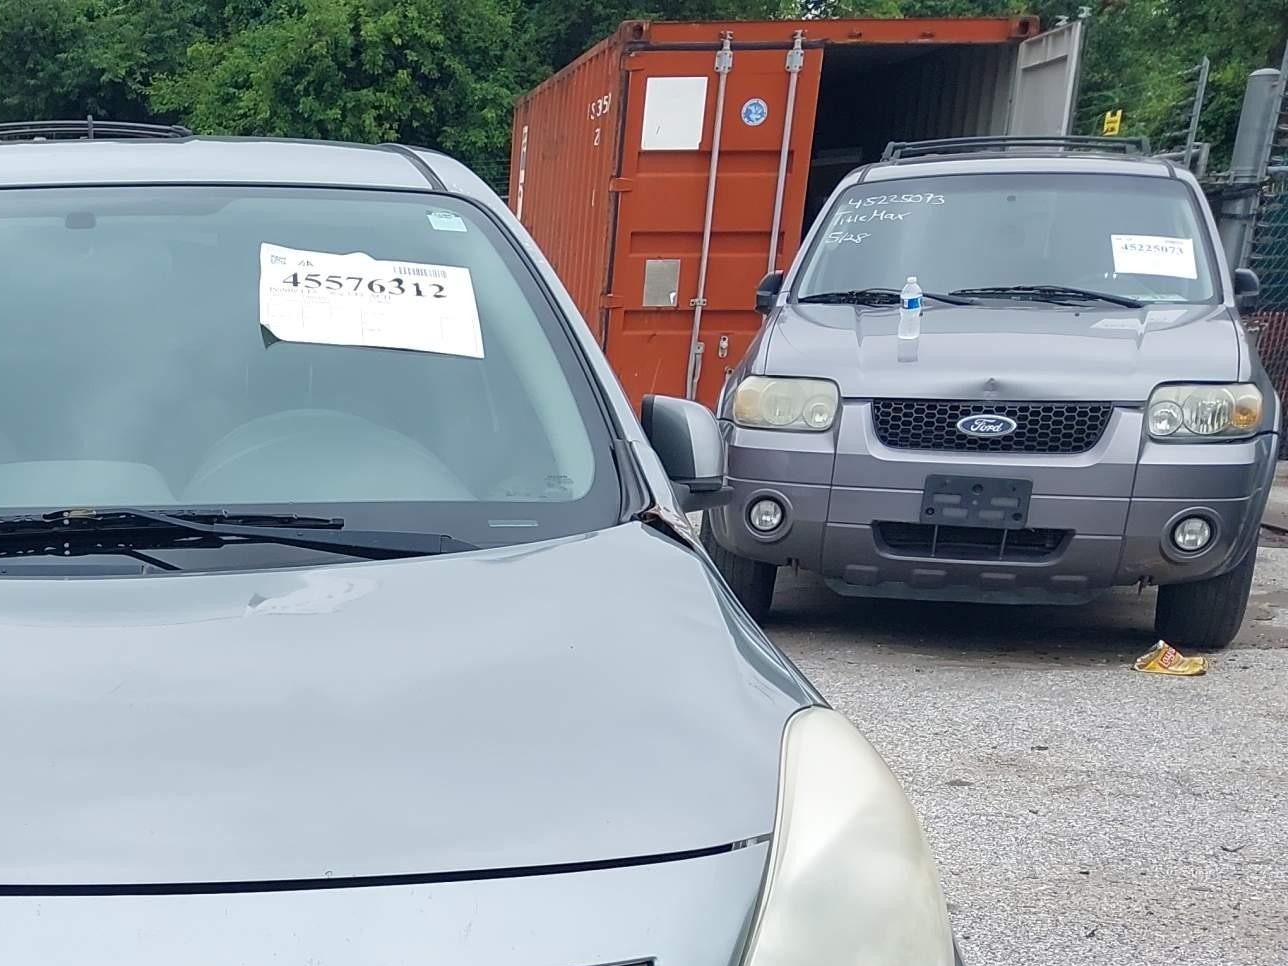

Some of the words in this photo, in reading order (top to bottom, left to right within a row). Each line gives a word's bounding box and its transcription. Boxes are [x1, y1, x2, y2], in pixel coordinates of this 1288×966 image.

[848, 193, 945, 208] 45225073
[1121, 243, 1184, 255] 45225073
[282, 272, 448, 299] 45576312
[970, 418, 1004, 432] Ford
